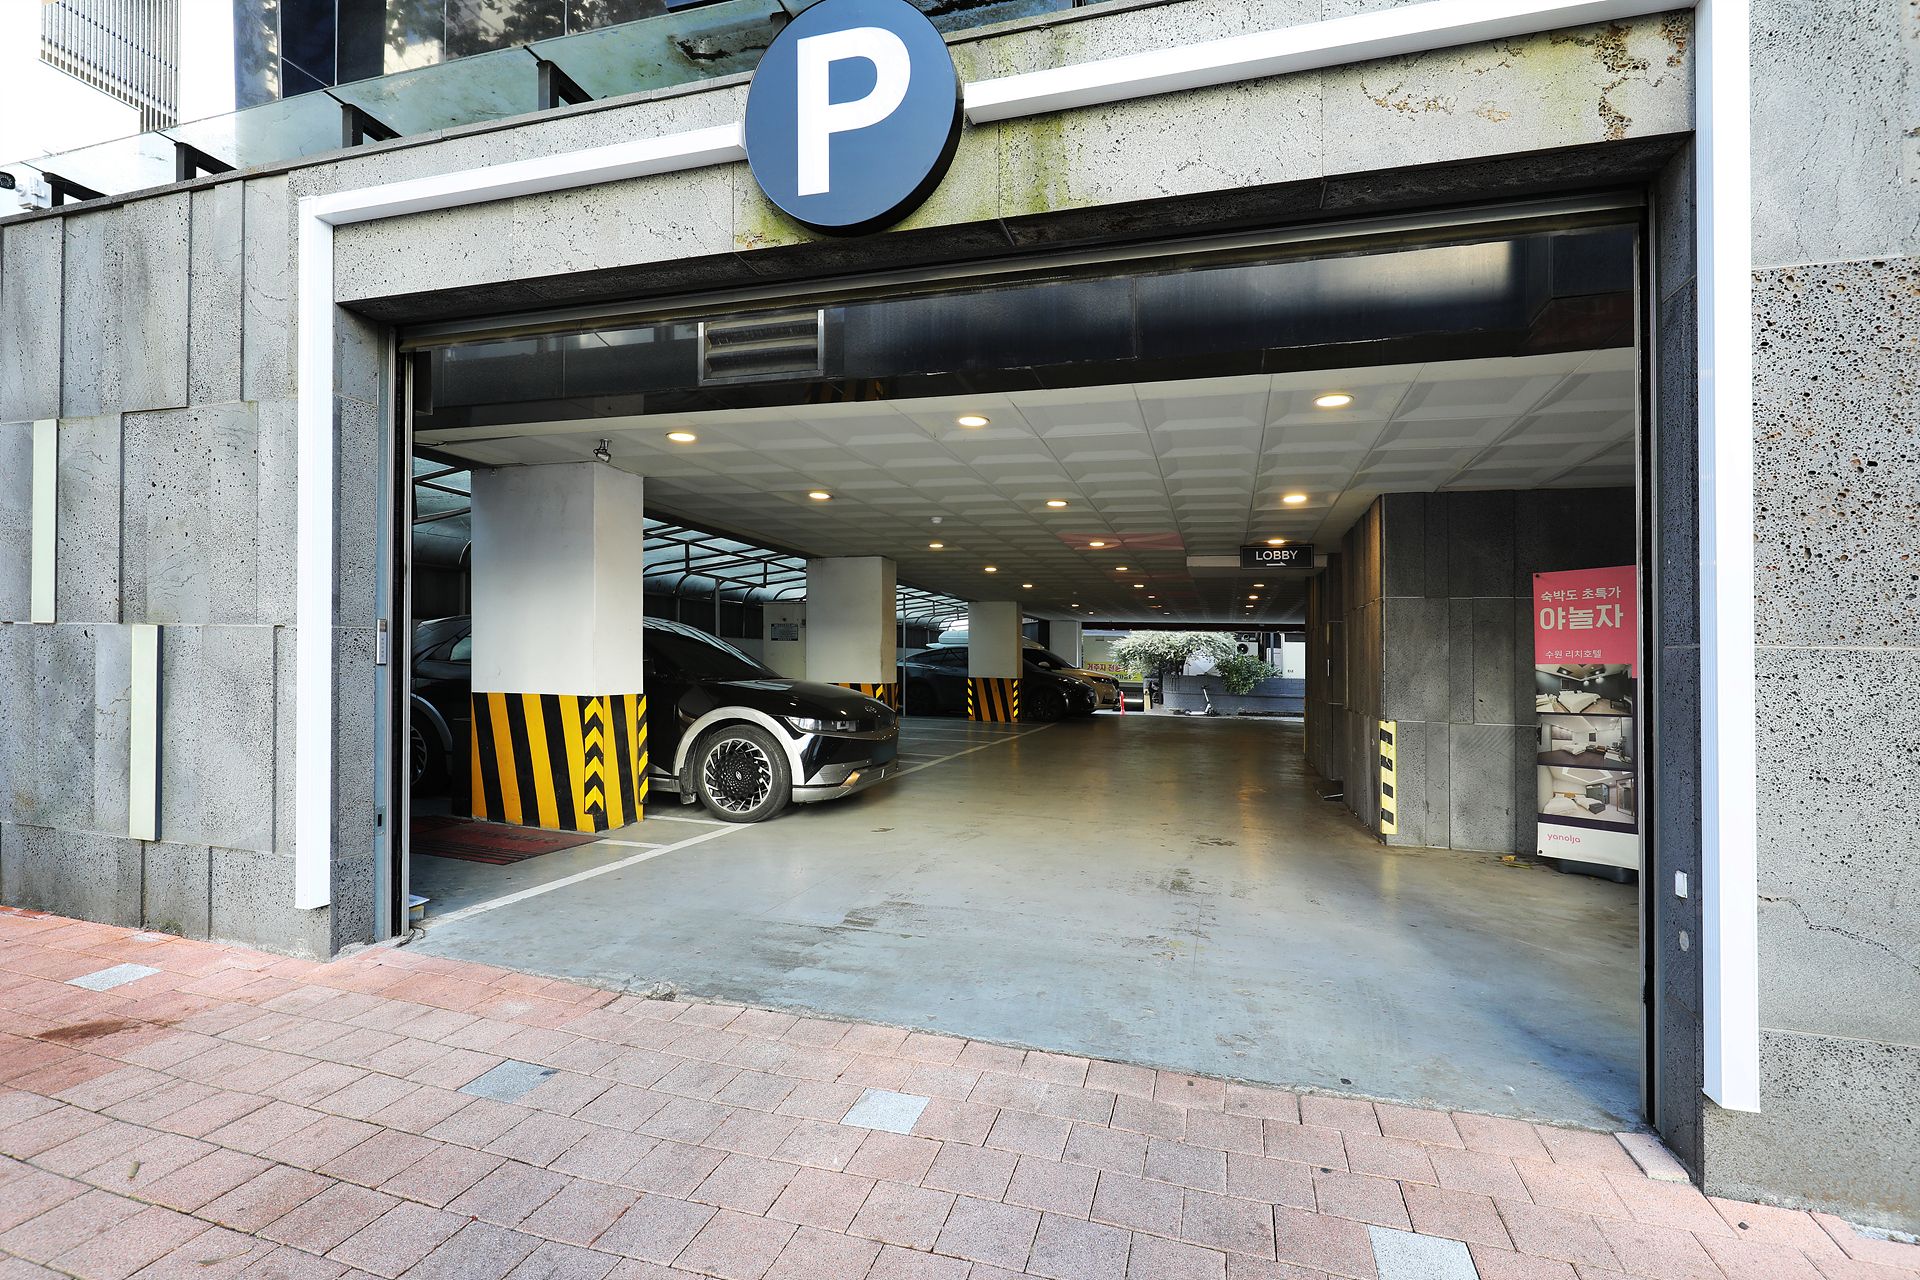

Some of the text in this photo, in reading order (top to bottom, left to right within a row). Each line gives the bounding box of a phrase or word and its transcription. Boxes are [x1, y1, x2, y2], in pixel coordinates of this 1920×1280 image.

[797, 26, 911, 197] P
[1255, 550, 1298, 561] LOBBY
[1541, 586, 1621, 602] 숙박도 초특가
[1539, 604, 1624, 630] 야놀자
[1545, 649, 1602, 659] 수원 리치호텔
[1547, 833, 1581, 844] yanolja
